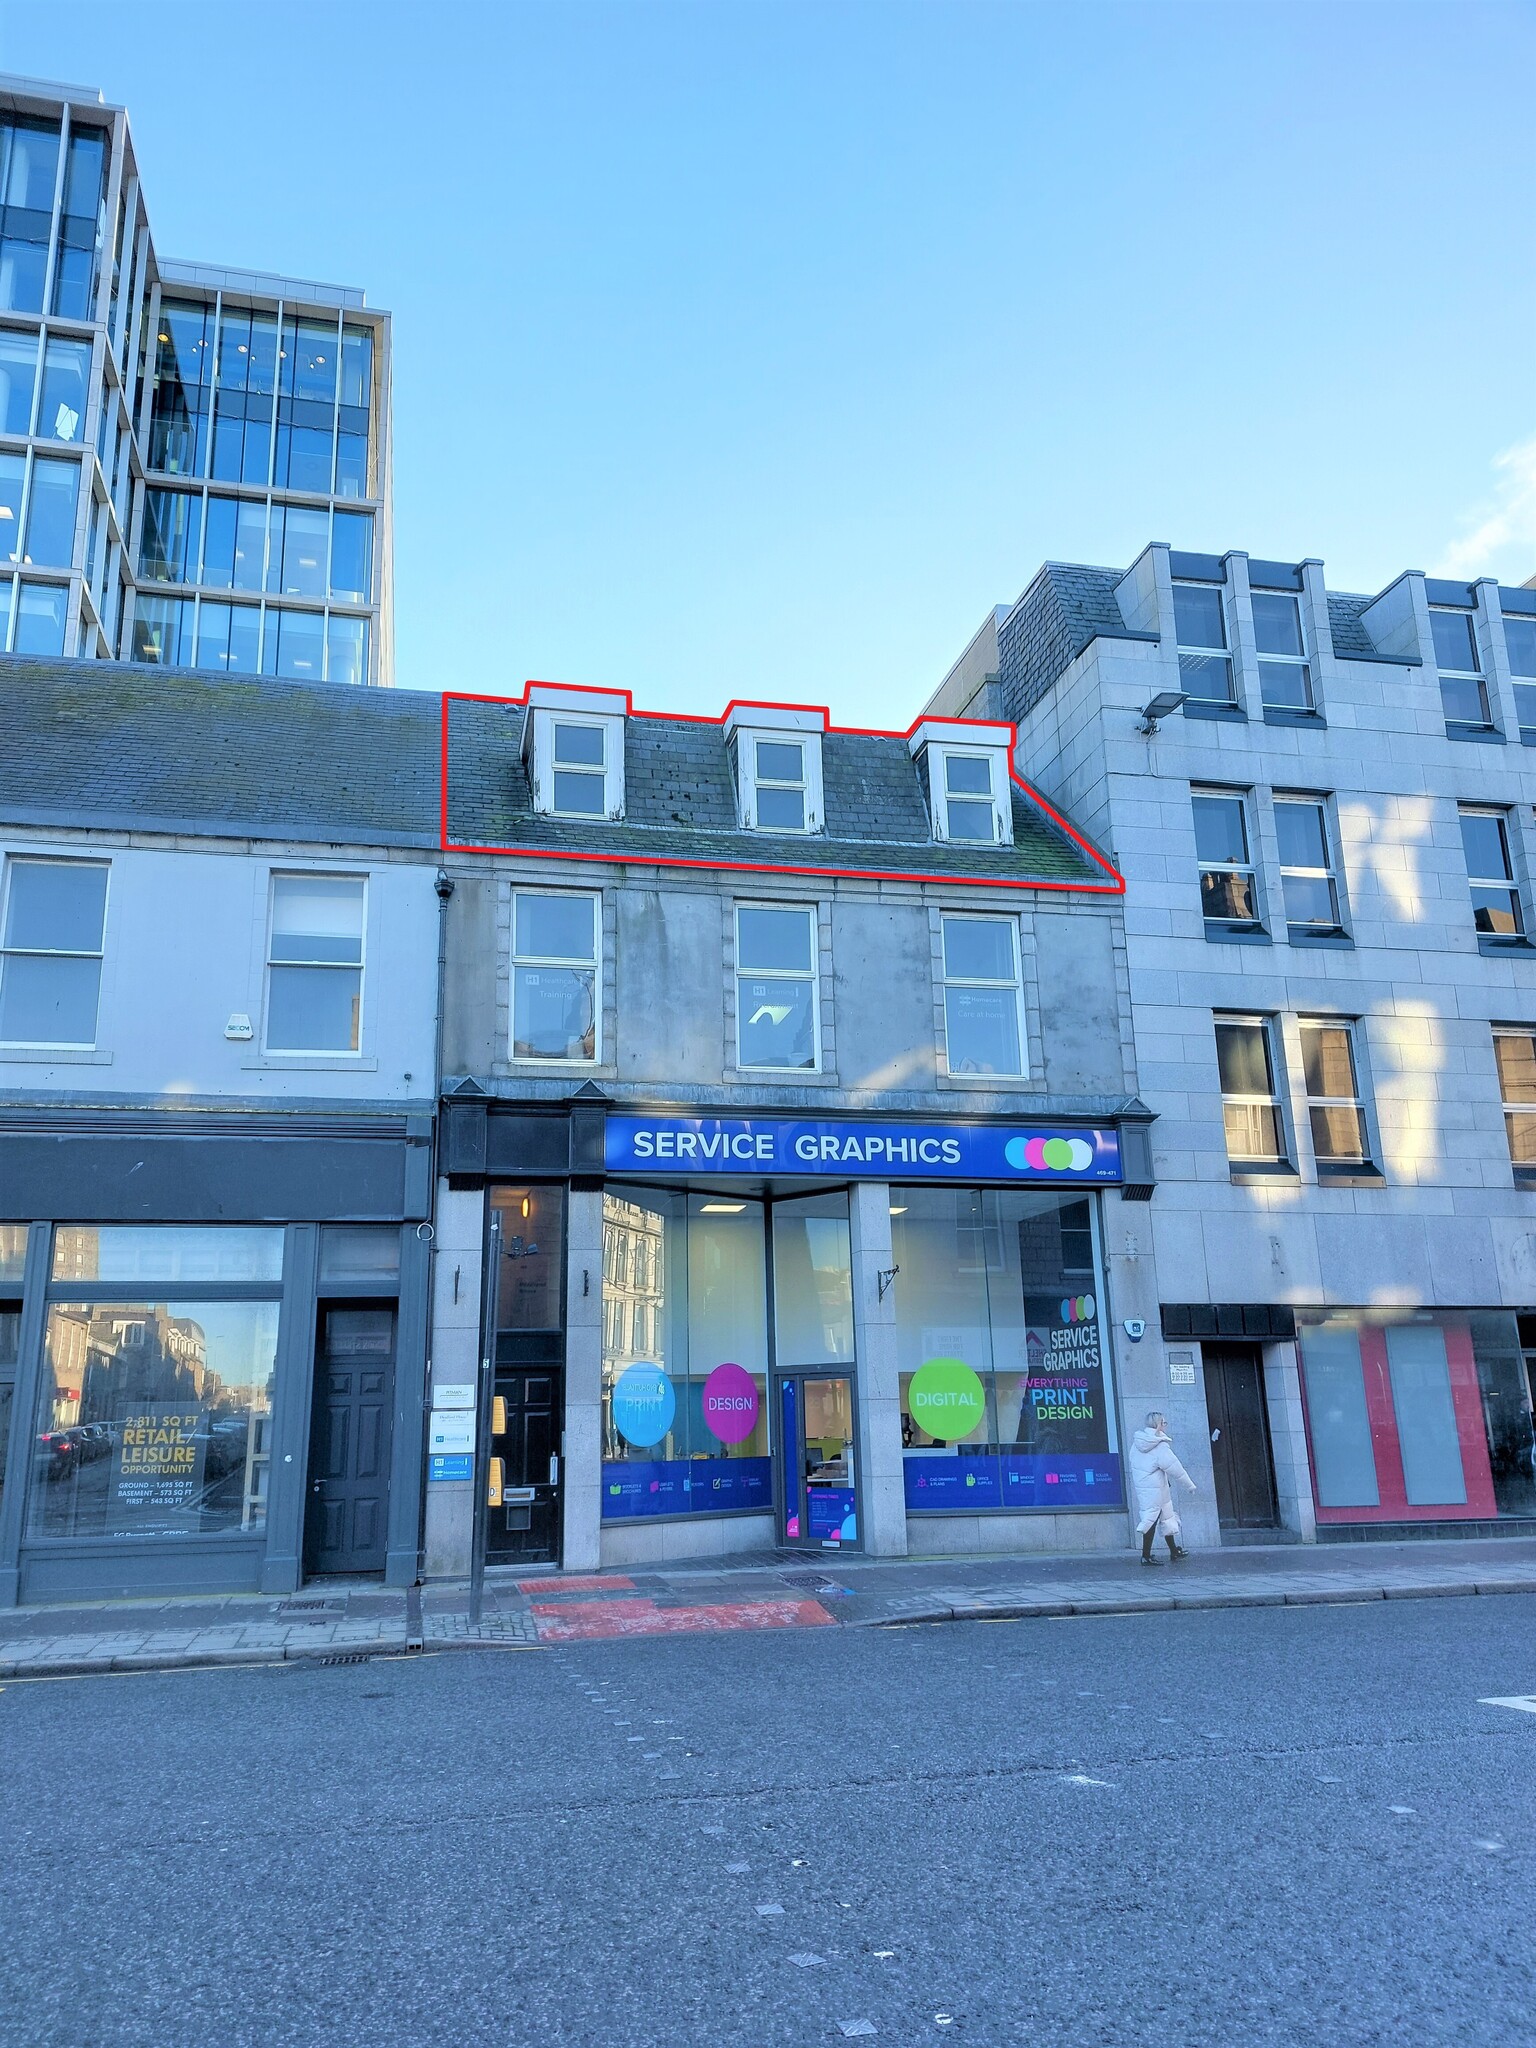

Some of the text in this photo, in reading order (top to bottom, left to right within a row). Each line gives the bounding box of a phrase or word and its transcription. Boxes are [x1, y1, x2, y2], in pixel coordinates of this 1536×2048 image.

[540, 990, 572, 999] Training
[986, 1010, 1006, 1018] home
[633, 1130, 961, 1164] SERVICE GRAPHICS
[1051, 1325, 1098, 1350] SERVICE
[1043, 1347, 1100, 1372] GRAPHICS
[1020, 1377, 1088, 1388] EVERYTHING
[708, 1397, 752, 1411] DESIGN
[916, 1392, 978, 1407] DIGITAL
[1031, 1388, 1089, 1406] PRINT
[626, 1398, 662, 1412] PRINT
[1036, 1406, 1094, 1420] DESIGN
[125, 1415, 198, 1428] 2,811 SQ FT
[123, 1428, 197, 1445] RETAIL/
[121, 1447, 196, 1463] LEISURE
[120, 1464, 194, 1474] OPPORTUNITY
